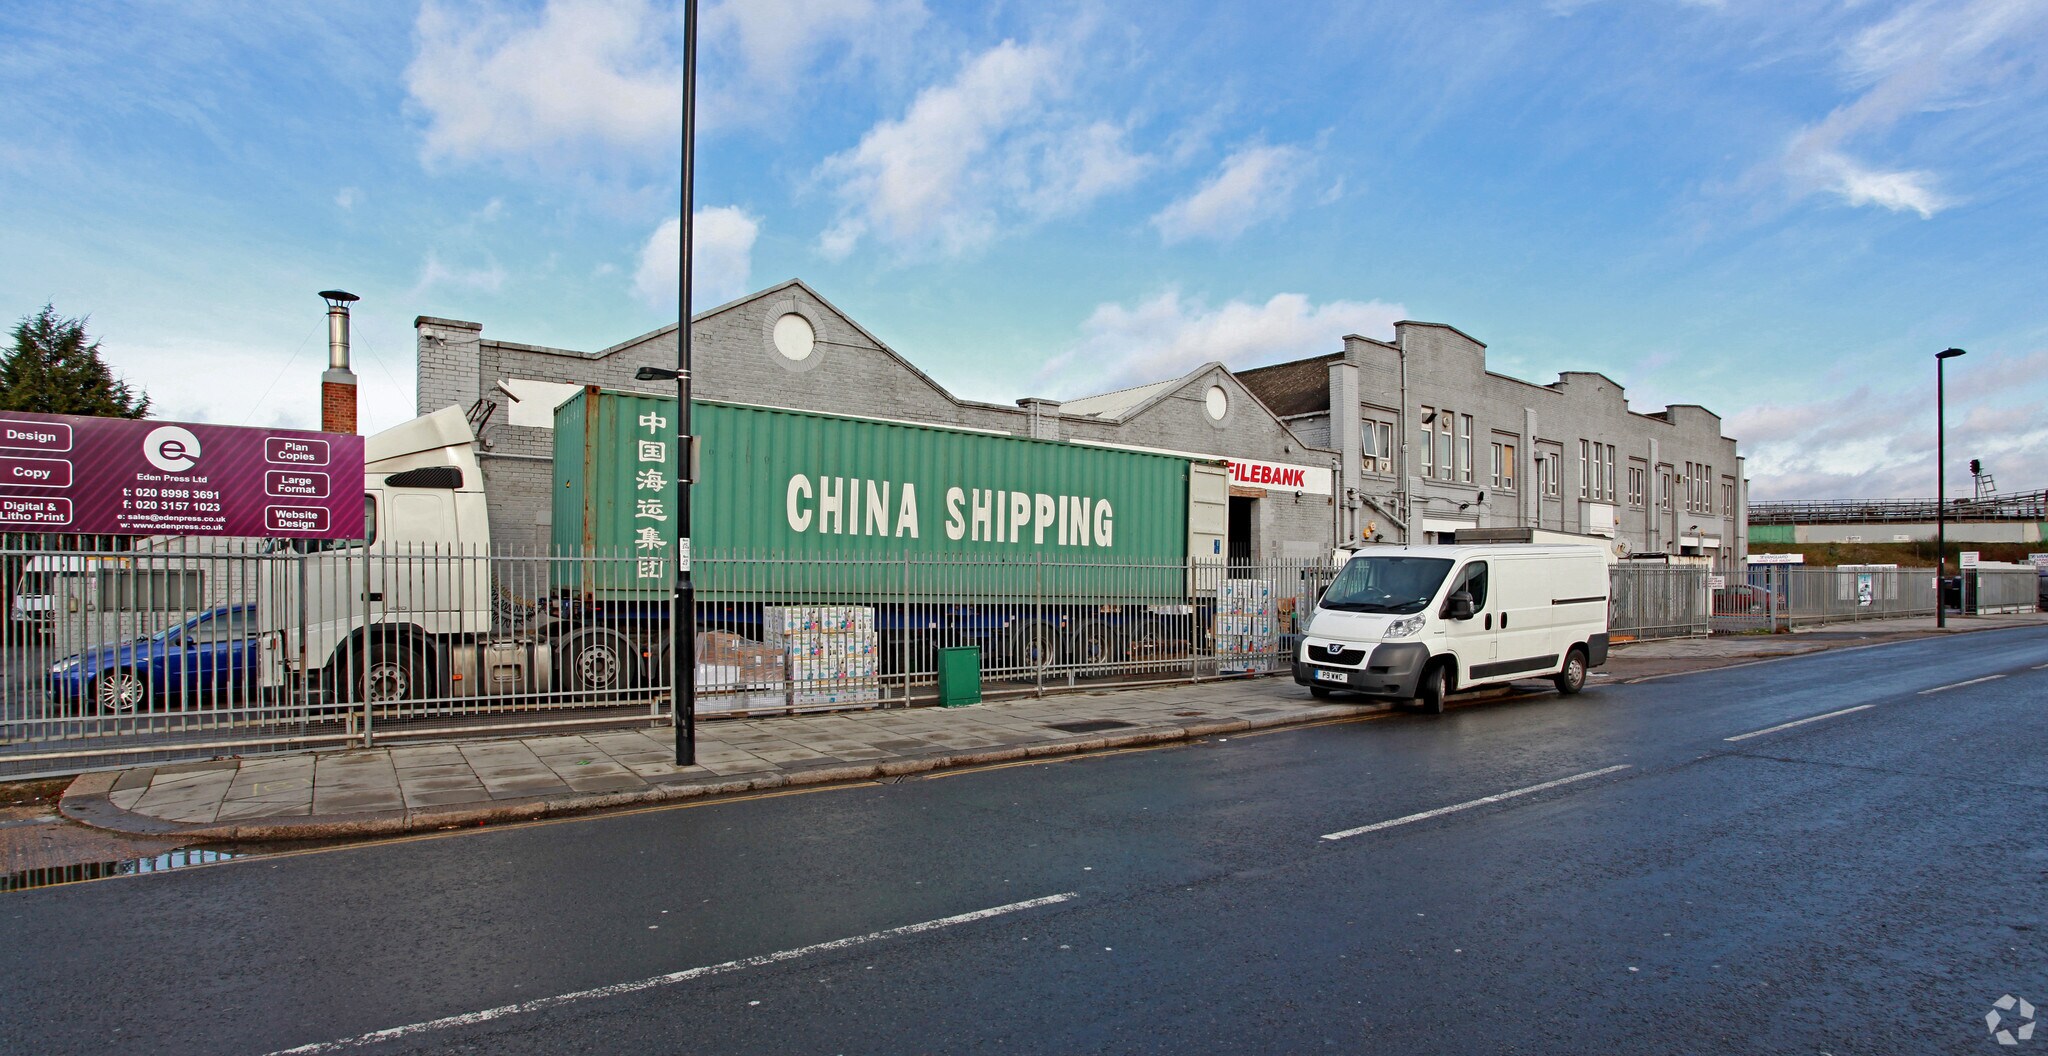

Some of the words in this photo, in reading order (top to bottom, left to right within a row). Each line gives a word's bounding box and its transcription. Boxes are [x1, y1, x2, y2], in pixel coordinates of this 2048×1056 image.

[6, 429, 57, 443] Design
[284, 442, 309, 452] Plan
[277, 450, 316, 462] Copies
[13, 466, 51, 480] Copy
[136, 473, 161, 481] Eden
[163, 474, 190, 483] Press
[192, 475, 208, 483] Ltd
[1228, 462, 1305, 487] FILEBANK
[281, 475, 312, 487] Large
[122, 487, 132, 497] t:
[135, 488, 158, 497] 020
[161, 489, 189, 499] 8998
[192, 490, 220, 500] 3691
[277, 484, 316, 494] Format
[635, 412, 668, 579] 中国海运集团
[3, 501, 44, 513] Digital
[47, 502, 57, 512] &
[122, 499, 132, 509] f:
[135, 500, 158, 510] 020
[161, 501, 190, 511] 3157
[193, 502, 221, 512] 1023
[786, 473, 919, 539] CHINA
[945, 486, 1113, 547] SHIPPING
[0, 511, 32, 521] Litho
[34, 512, 65, 522] Print
[127, 513, 227, 523] sales@edenpress.co.uk
[275, 509, 318, 520] Website
[132, 523, 224, 531] www.edenpress.co.uk
[278, 518, 316, 531] Design
[1322, 671, 1330, 679] P9
